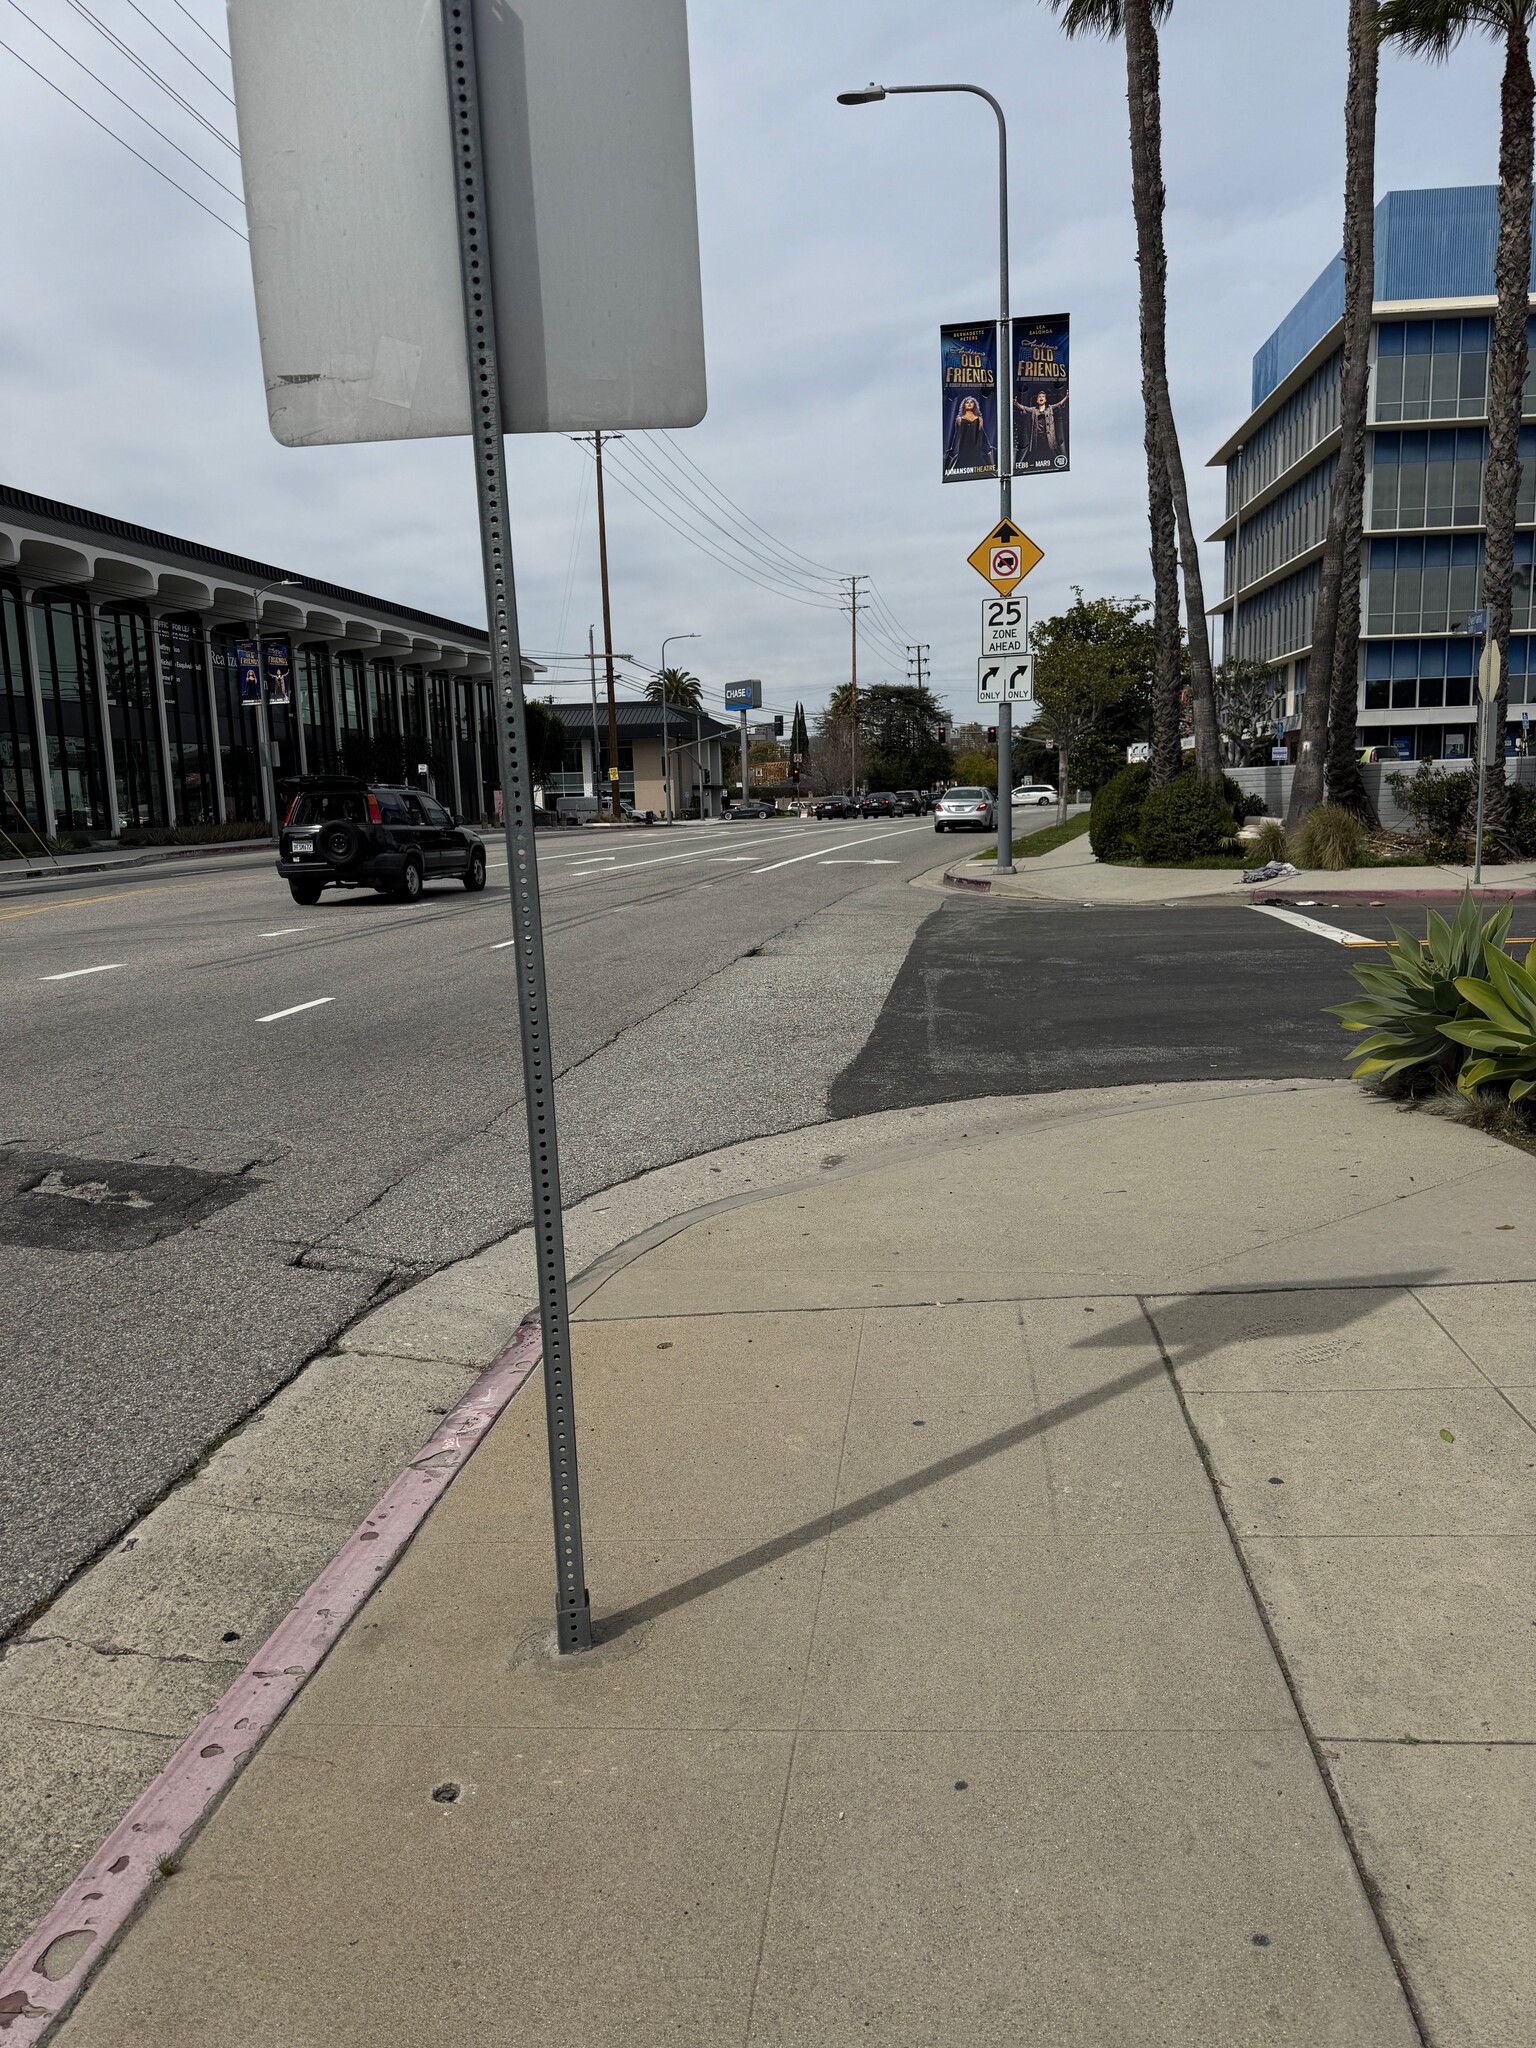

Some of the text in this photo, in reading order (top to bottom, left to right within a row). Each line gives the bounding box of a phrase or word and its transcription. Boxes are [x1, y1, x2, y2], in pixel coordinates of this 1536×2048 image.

[961, 353, 982, 368] OLD
[1032, 347, 1054, 362] OLD
[946, 366, 994, 383] FRIENDS
[1017, 360, 1067, 377] FRIENDS
[988, 601, 1022, 626] 25
[992, 629, 1017, 639] ZONE
[988, 641, 1021, 652] AHEAD
[211, 651, 238, 667] Reaiz
[726, 688, 746, 699] CHASE
[980, 691, 1001, 700] ONLY
[1008, 690, 1029, 698] ONLY
